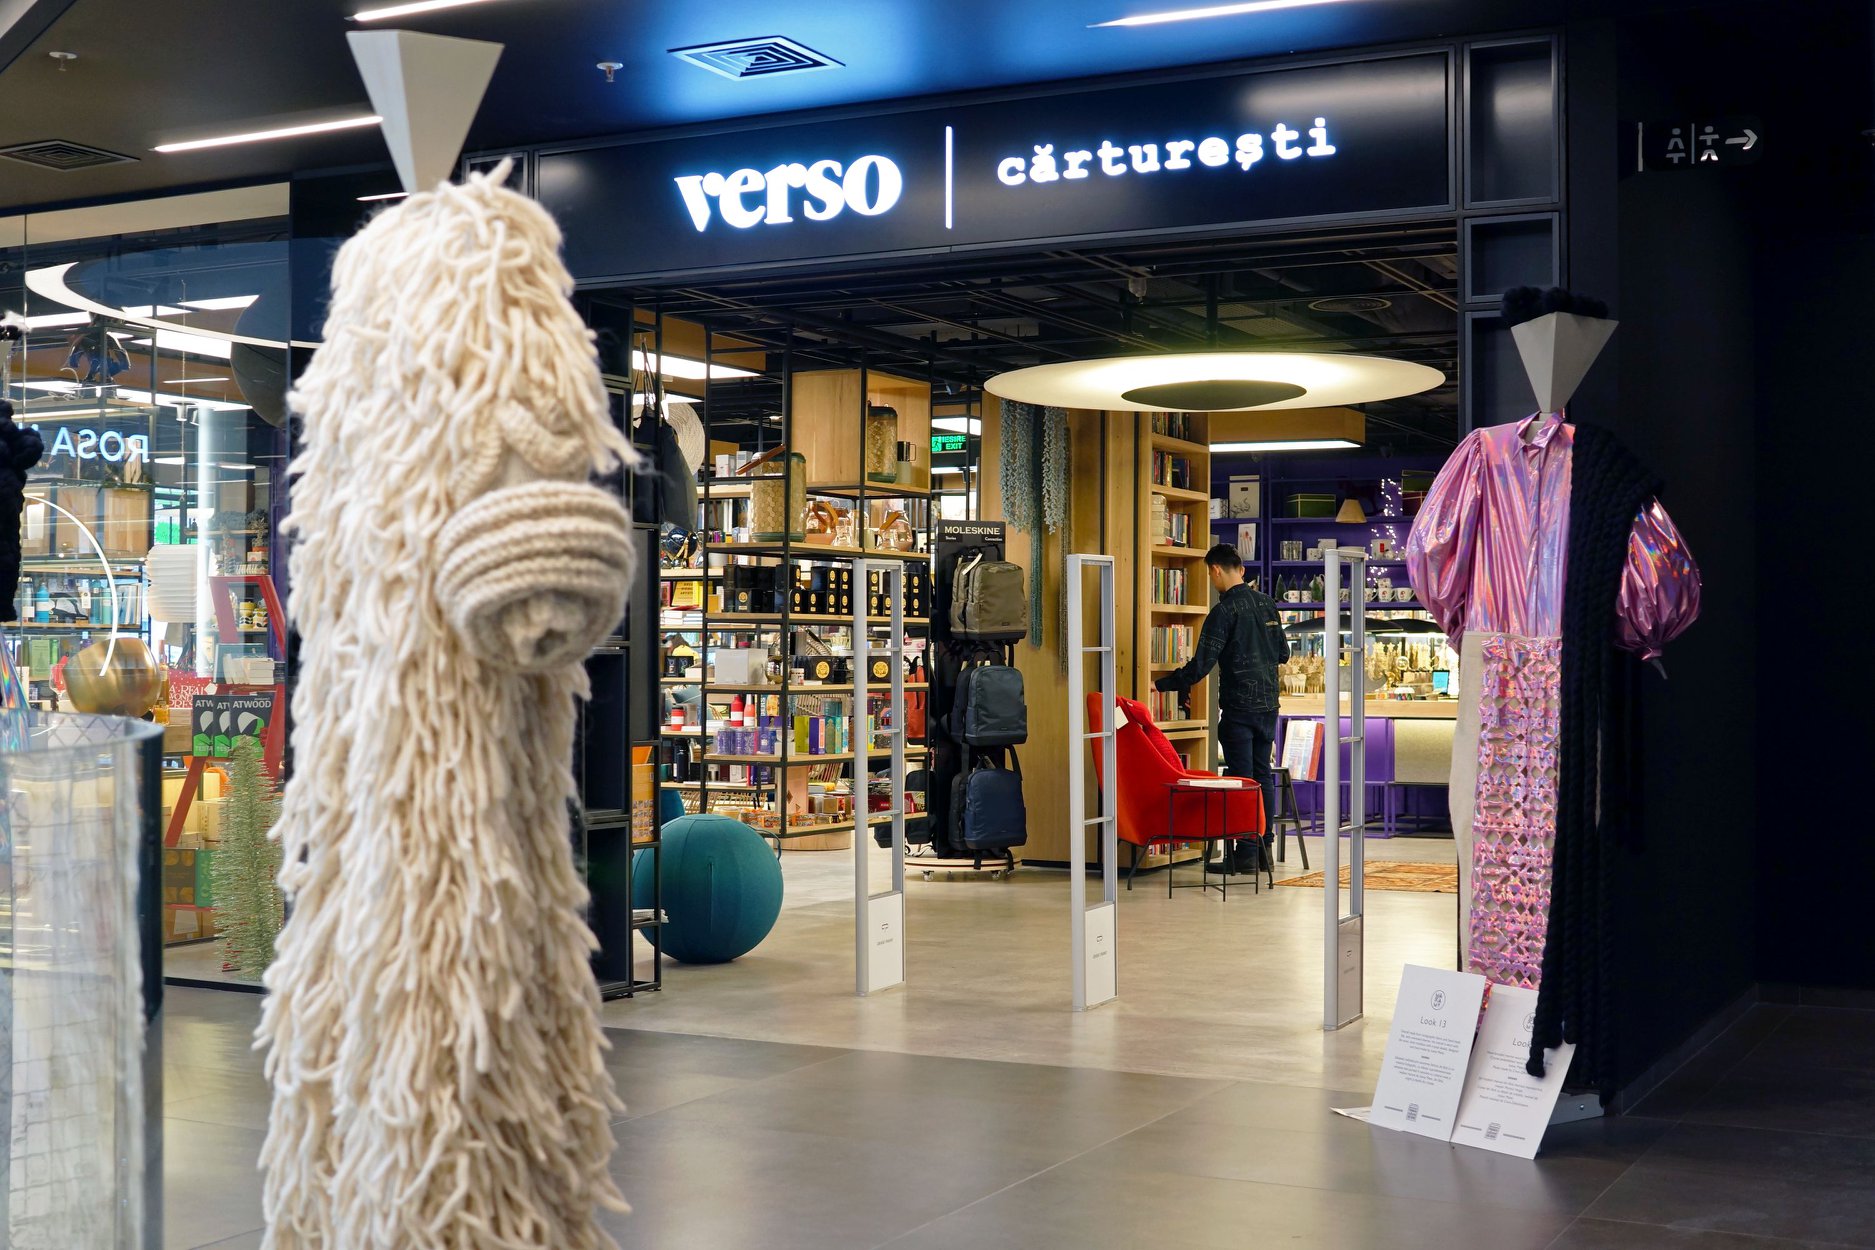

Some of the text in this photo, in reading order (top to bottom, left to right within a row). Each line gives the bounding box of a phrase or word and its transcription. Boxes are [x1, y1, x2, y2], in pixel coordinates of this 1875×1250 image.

[674, 117, 1336, 232] verso cărturești
[944, 526, 1001, 535] MOLESKINE
[232, 700, 272, 709] ATWOOD
[1420, 1016, 1447, 1028] Look 13
